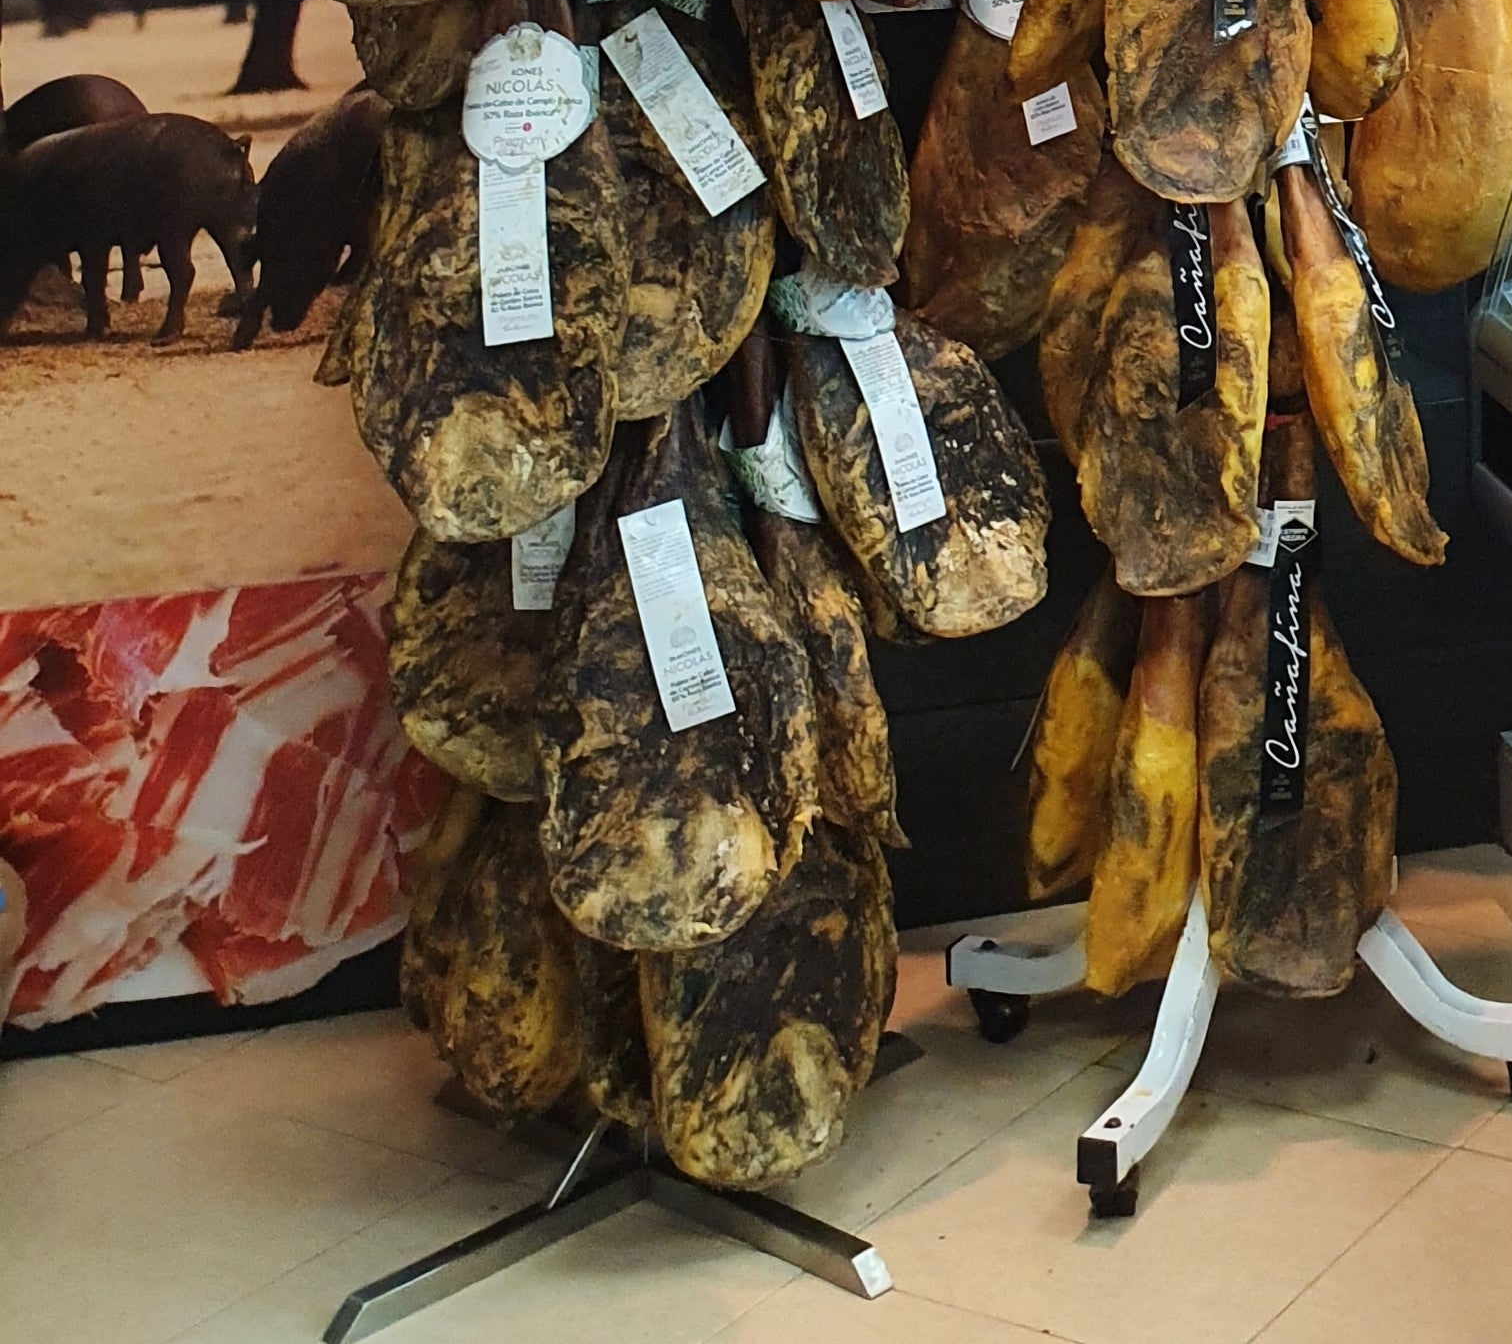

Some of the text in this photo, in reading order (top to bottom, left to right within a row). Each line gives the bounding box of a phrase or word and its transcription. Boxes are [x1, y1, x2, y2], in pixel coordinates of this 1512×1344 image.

[485, 78, 556, 96] NICOLAS
[1173, 202, 1213, 350] Cañafi
[1265, 562, 1308, 769] Cañafina
